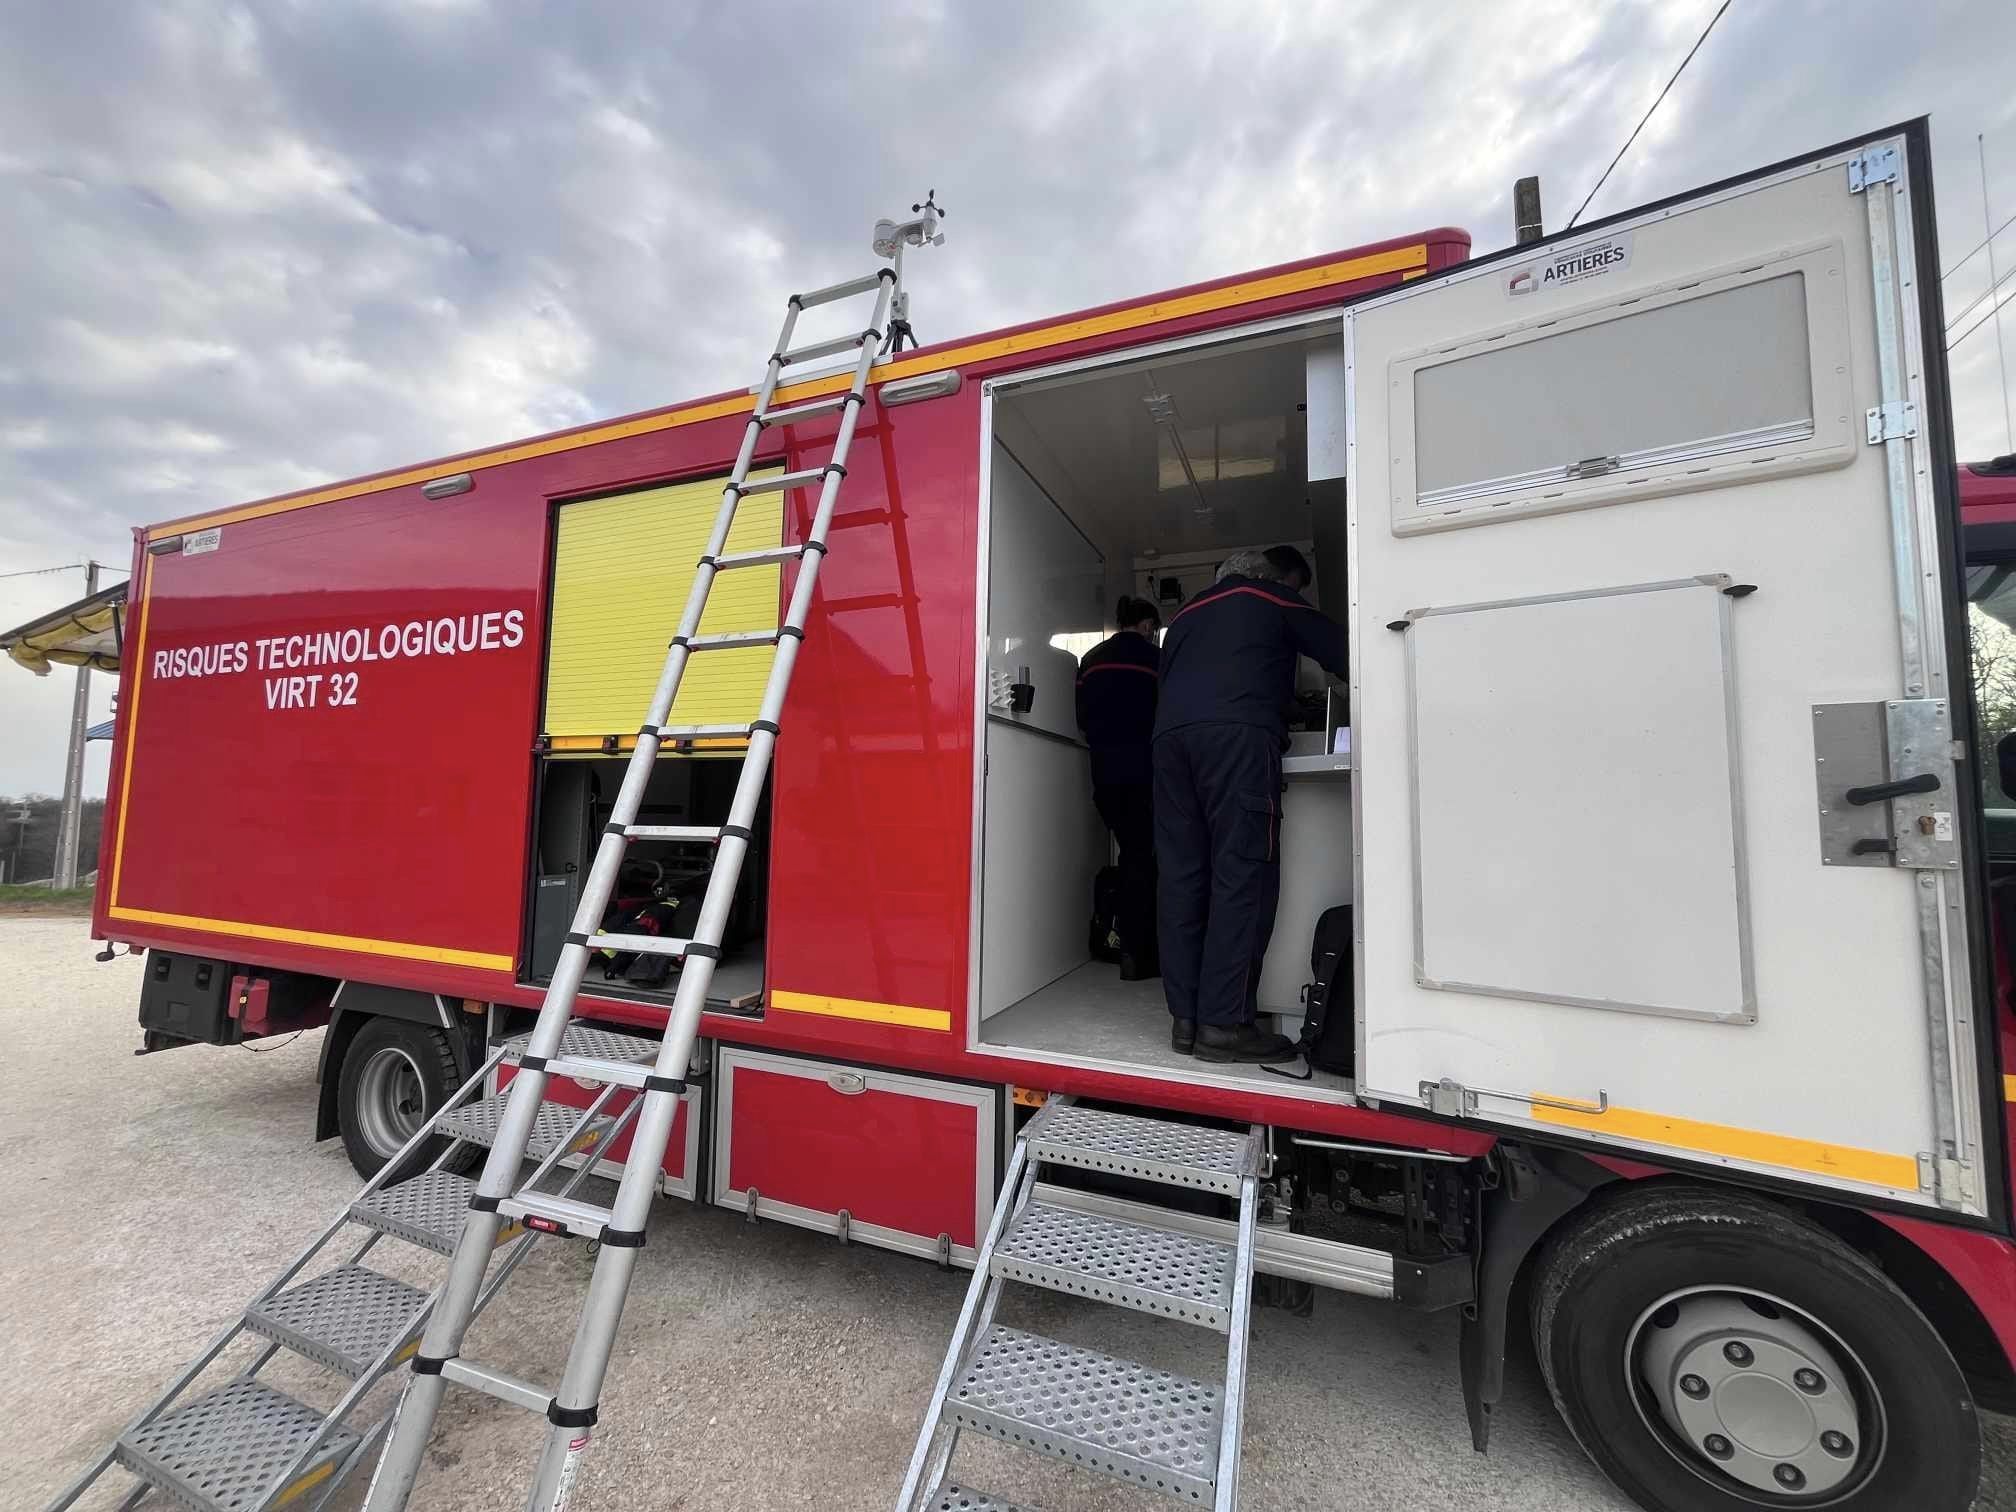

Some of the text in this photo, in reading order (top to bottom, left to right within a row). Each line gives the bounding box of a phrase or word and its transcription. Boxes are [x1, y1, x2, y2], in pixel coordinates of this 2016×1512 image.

[1543, 247, 1625, 282] ARTIERES
[153, 609, 525, 679] RISQUES TECHNOLOGIQUES
[265, 672, 359, 710] VIRT 32
